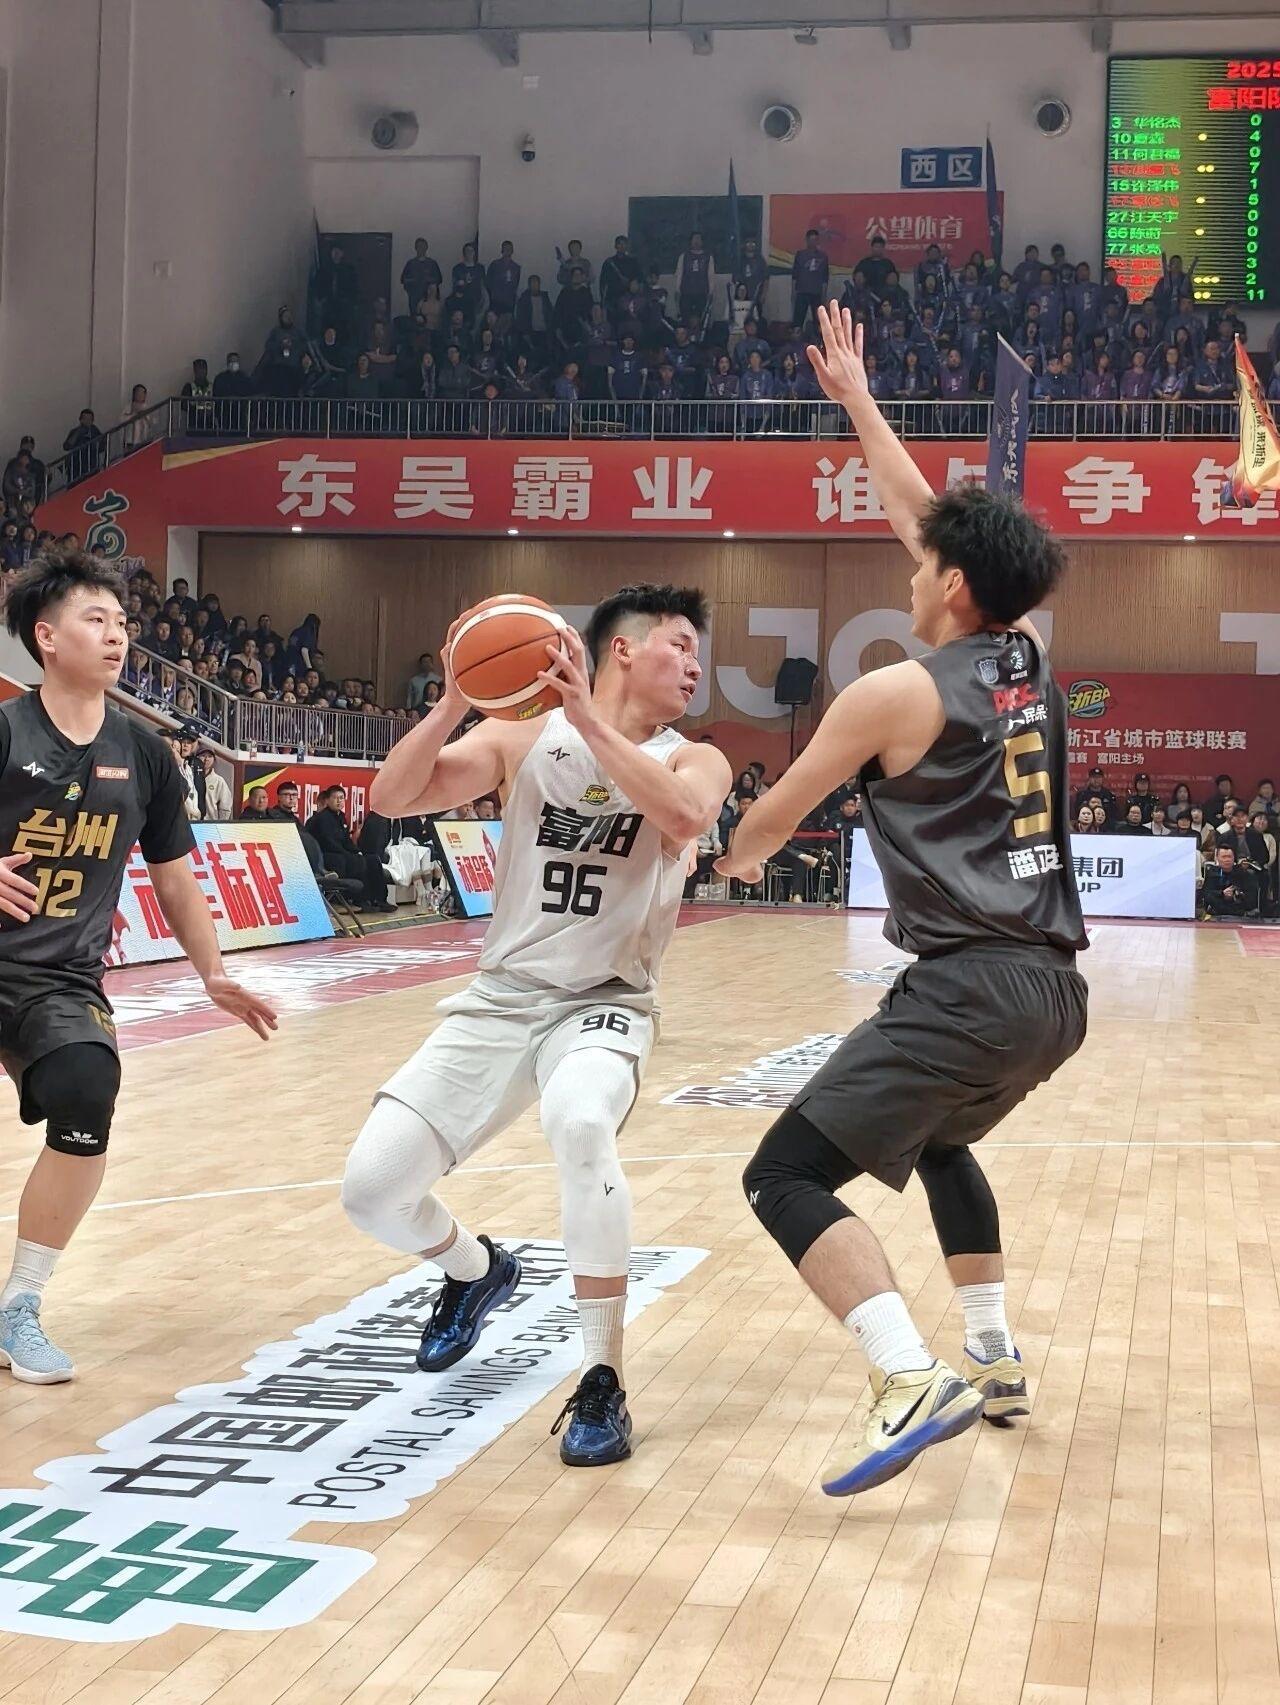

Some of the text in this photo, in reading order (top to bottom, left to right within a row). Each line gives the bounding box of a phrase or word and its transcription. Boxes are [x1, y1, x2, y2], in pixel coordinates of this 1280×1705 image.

[1250, 114, 1262, 126] 0
[1111, 134, 1131, 144] 10
[1249, 130, 1260, 142] 4
[1111, 149, 1129, 160] 11
[1249, 147, 1261, 158] 0
[909, 154, 974, 183] 西区
[1249, 162, 1260, 174] 7
[1250, 178, 1258, 190] 1
[1107, 212, 1127, 224] 27
[1247, 209, 1259, 221] 0
[865, 215, 964, 241] 公望体育
[1247, 225, 1258, 237] 0
[1107, 244, 1127, 255] 77
[1246, 241, 1257, 253] 0
[1246, 257, 1257, 268] 3
[1245, 273, 1256, 285] 2
[1246, 289, 1265, 300] 11
[276, 454, 714, 520] 东吴霸业
[1003, 731, 1053, 839] 5
[11, 808, 119, 860] 台州
[536, 801, 645, 858] 富阳
[31, 867, 84, 917] 12
[541, 860, 608, 917] 96
[580, 1012, 631, 1036] 96
[286, 1427, 456, 1509] POSTAL
[411, 1346, 552, 1420] SAVINGS
